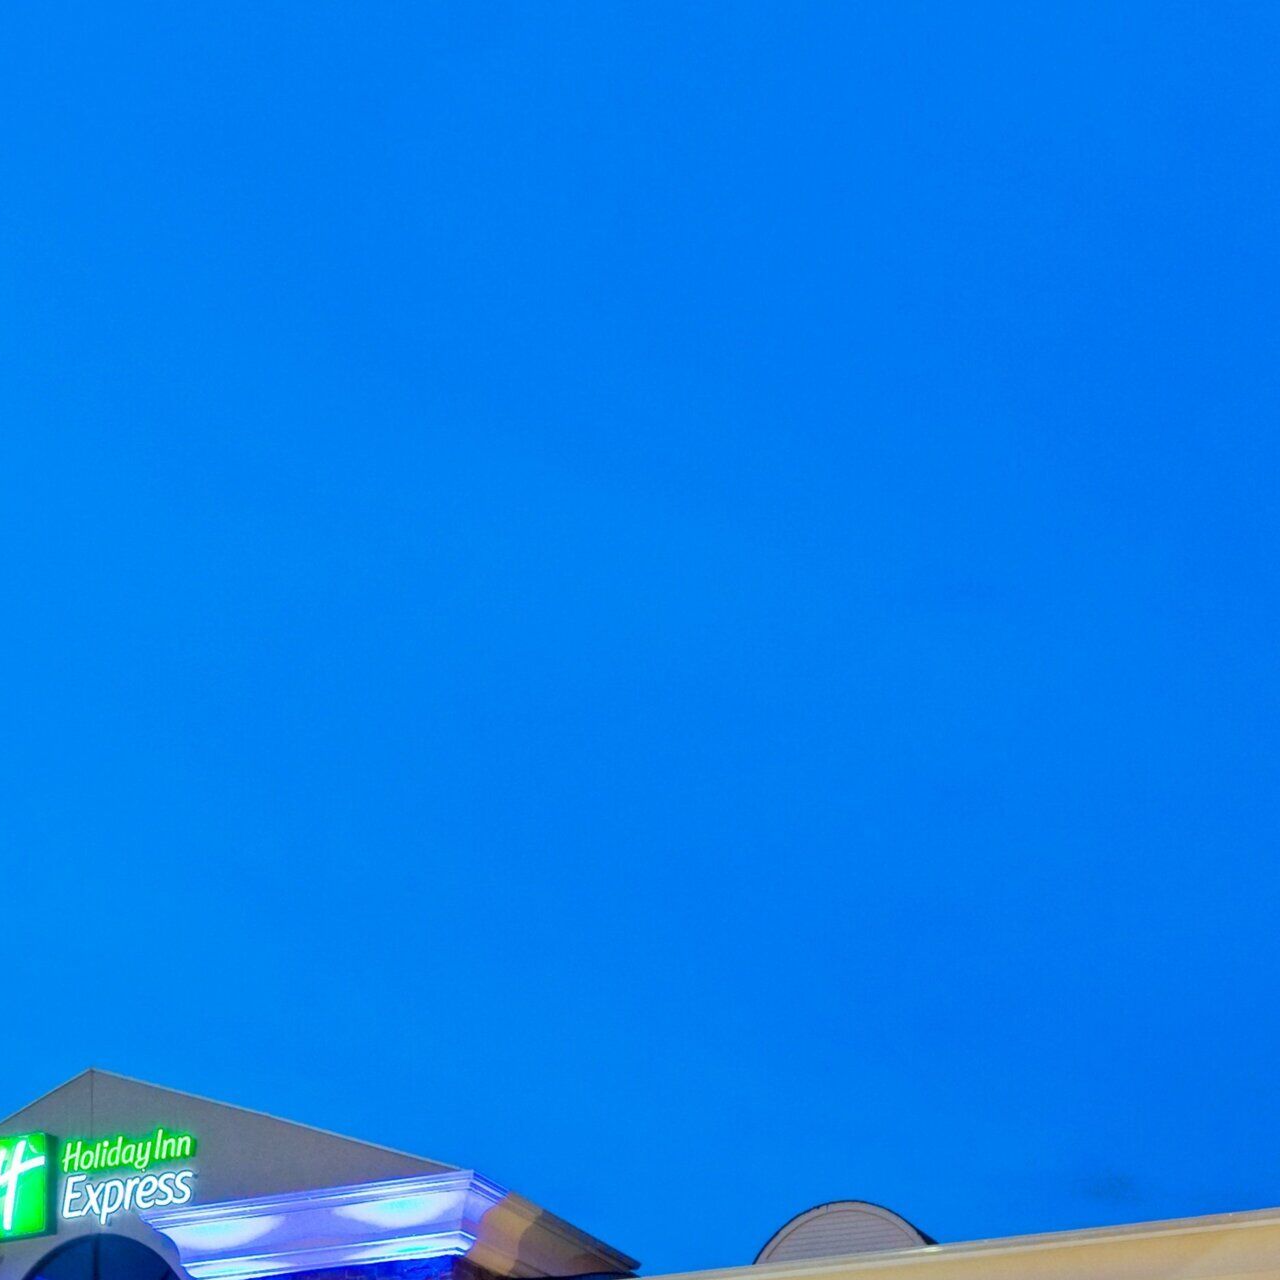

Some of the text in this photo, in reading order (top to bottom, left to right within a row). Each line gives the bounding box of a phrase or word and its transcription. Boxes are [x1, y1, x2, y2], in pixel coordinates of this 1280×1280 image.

[63, 1128, 192, 1173] Holiday Inn
[62, 1170, 193, 1225] Express
